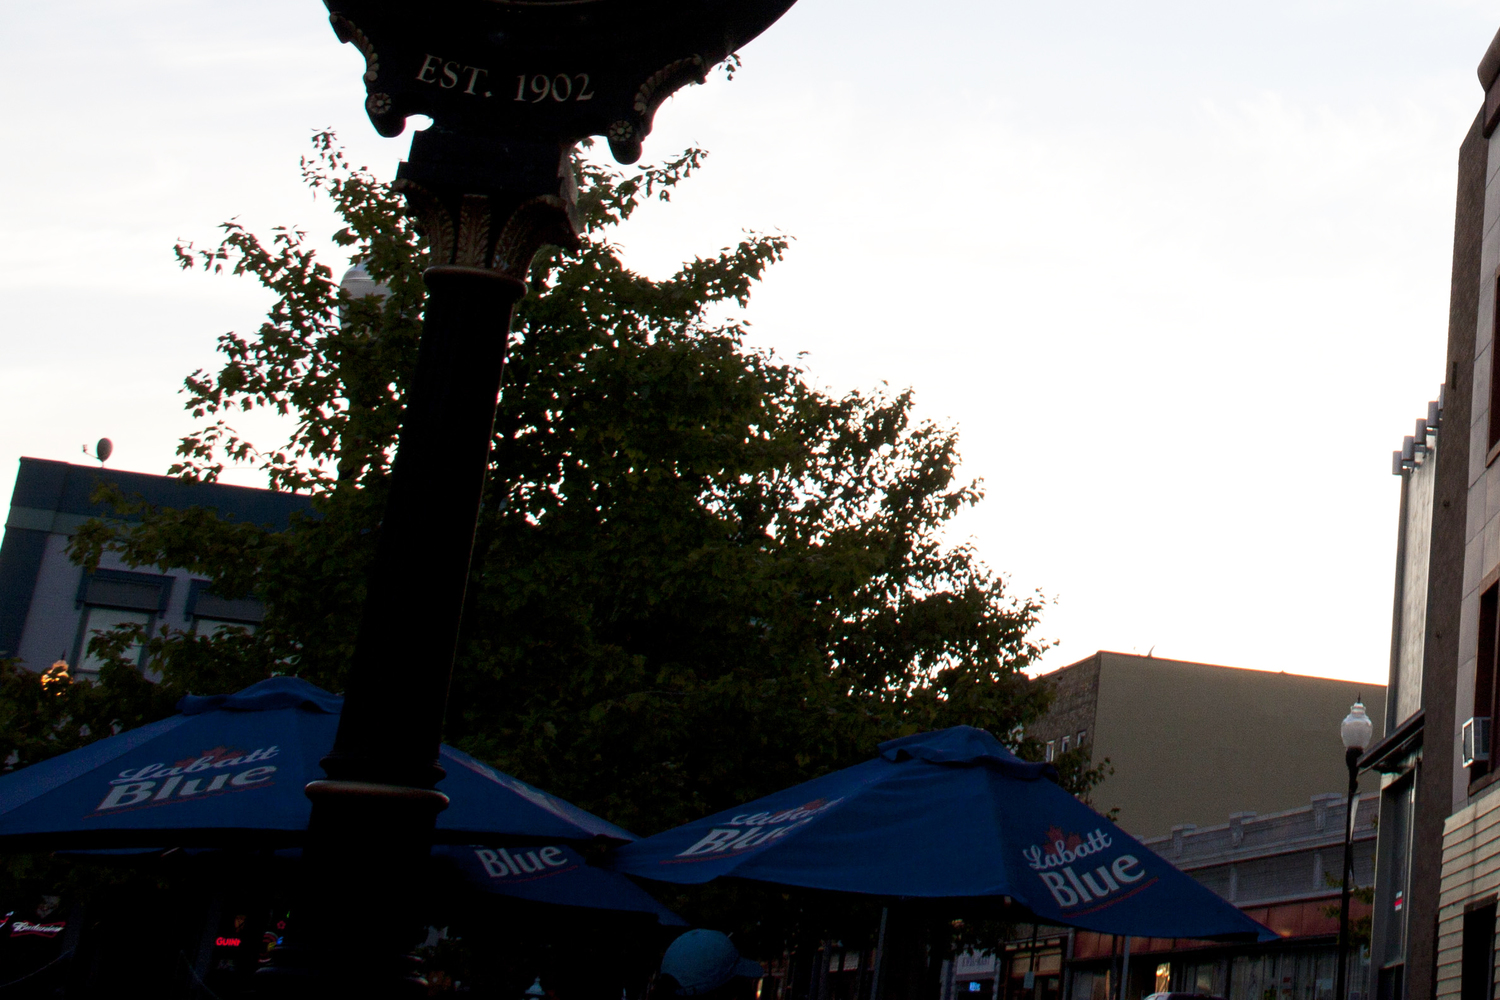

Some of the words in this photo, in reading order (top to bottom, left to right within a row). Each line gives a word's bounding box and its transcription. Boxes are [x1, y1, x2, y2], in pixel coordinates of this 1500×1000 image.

[414, 53, 493, 99] EST.
[513, 72, 596, 104] 1902
[96, 765, 278, 811] Blue
[108, 745, 280, 786] Labatt
[474, 845, 569, 878] Blue
[1022, 827, 1113, 871] Labatt
[1038, 854, 1146, 908] Blue
